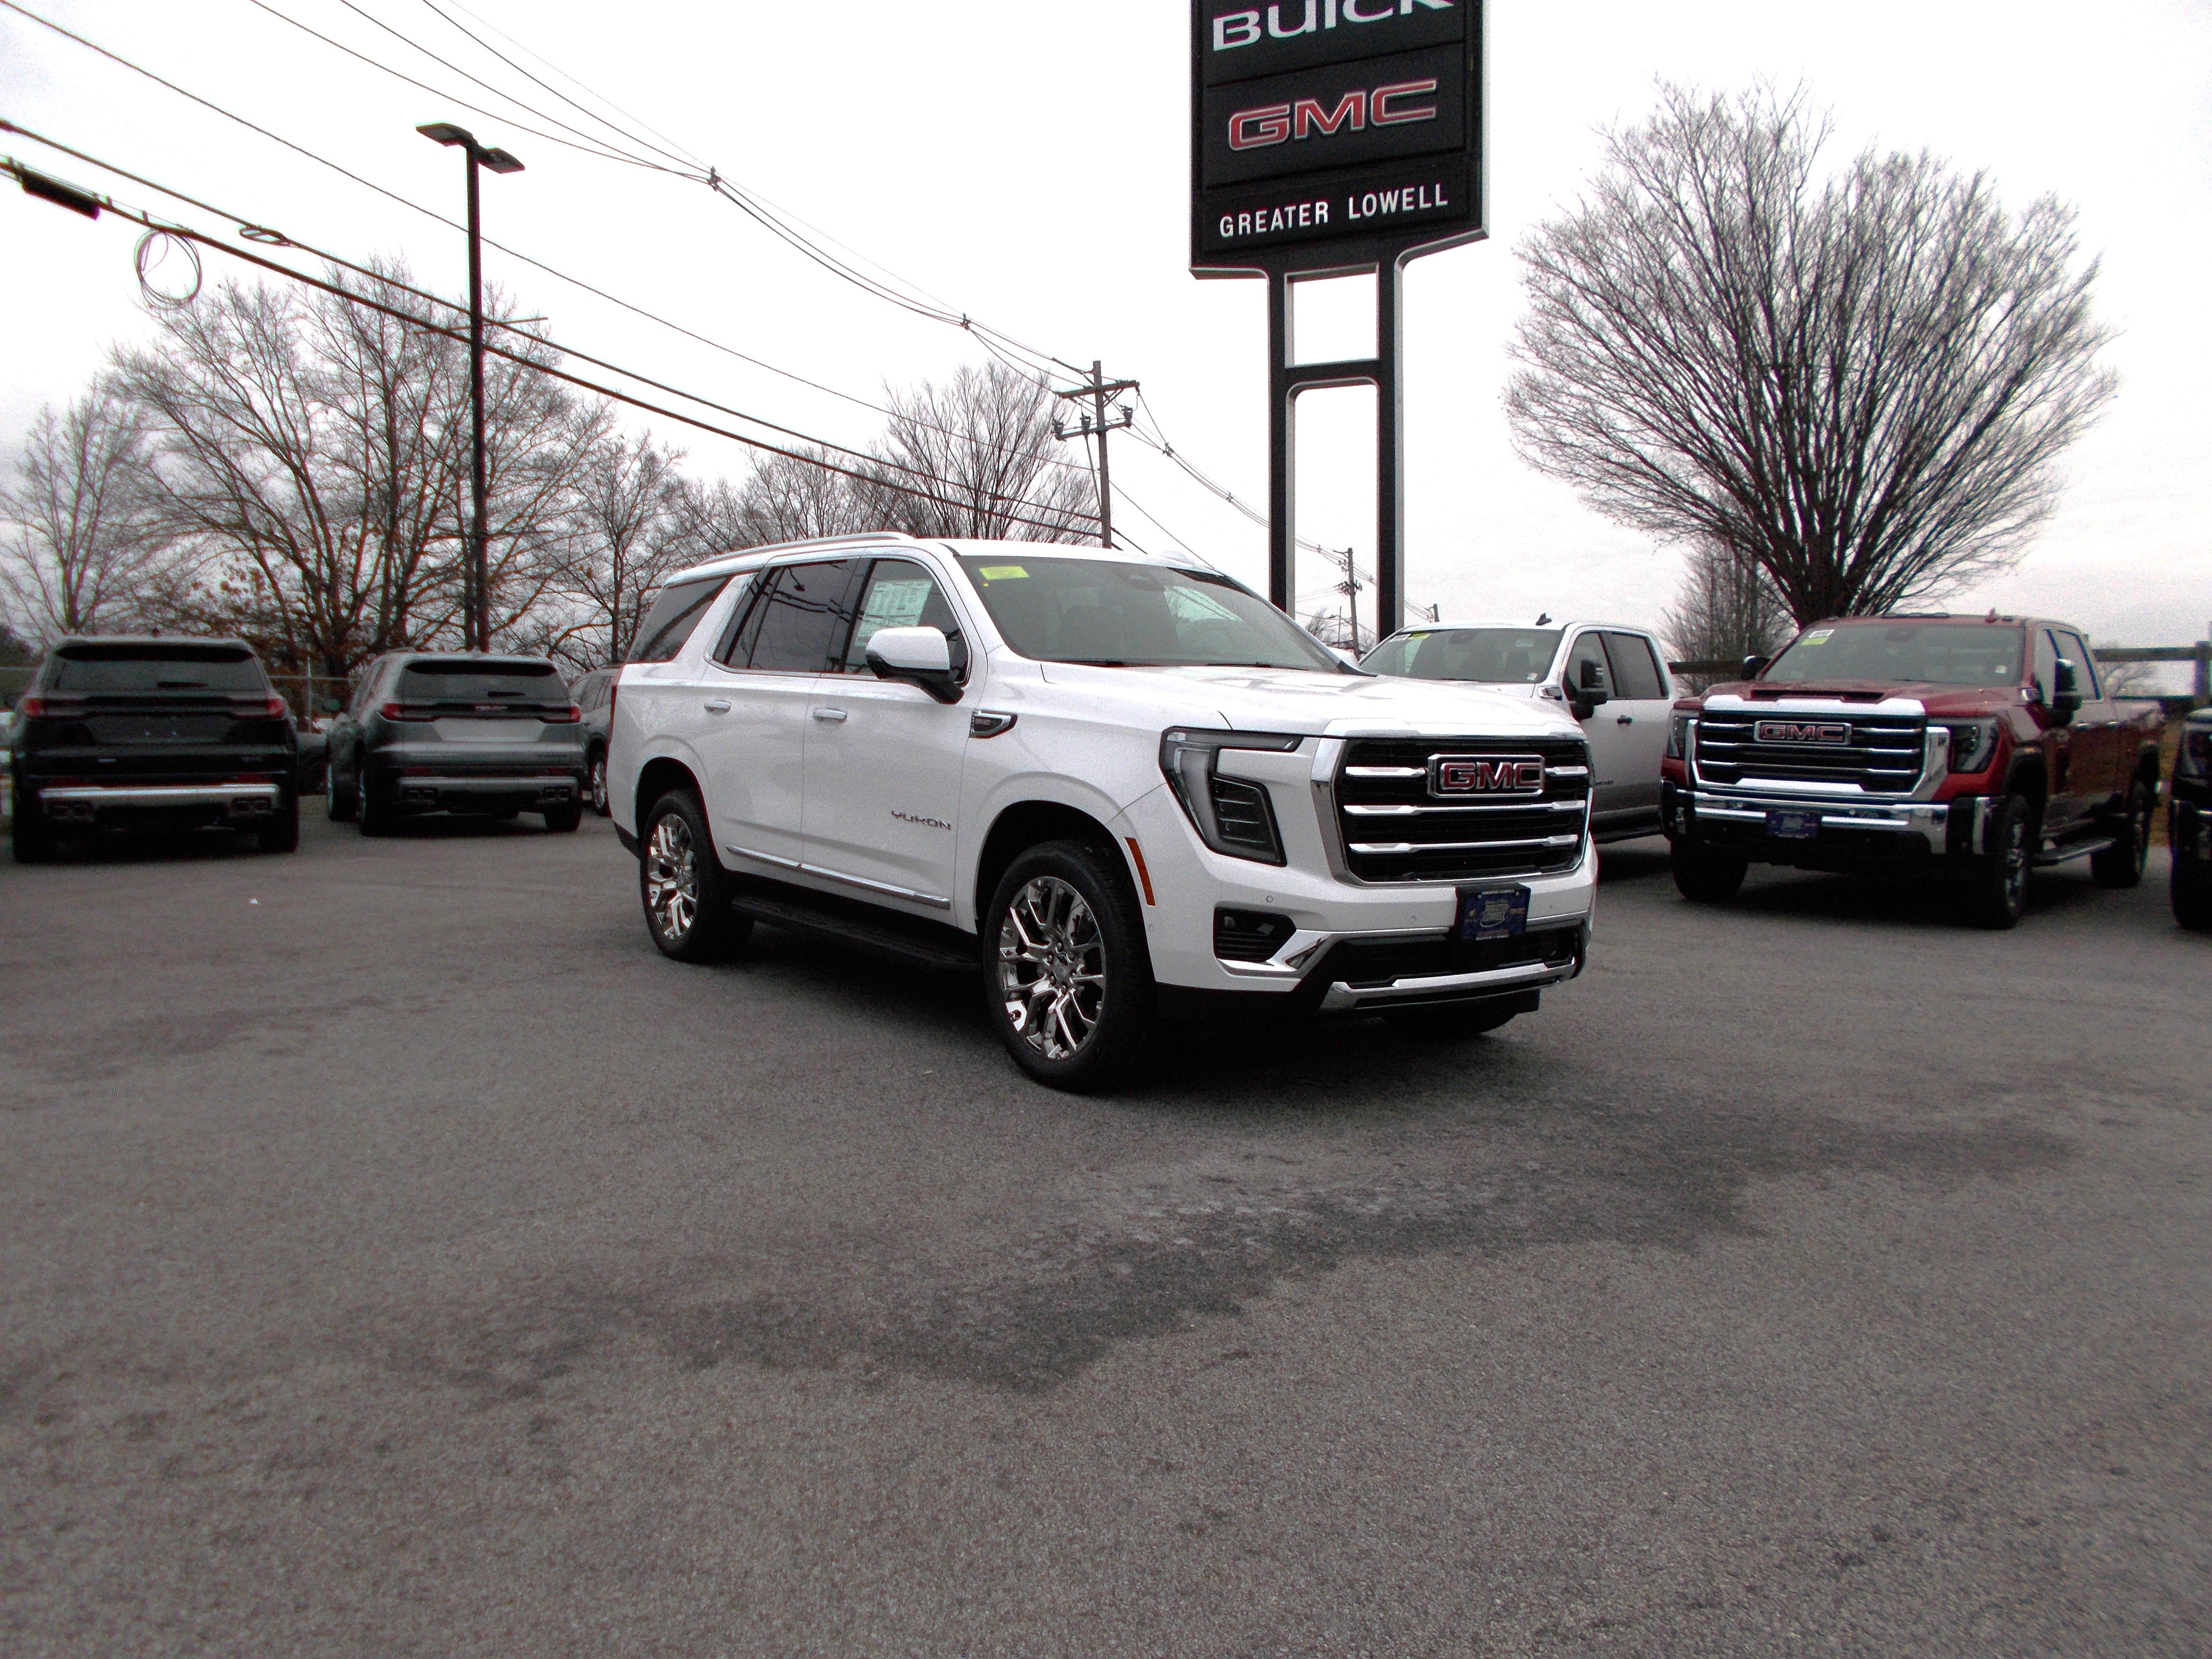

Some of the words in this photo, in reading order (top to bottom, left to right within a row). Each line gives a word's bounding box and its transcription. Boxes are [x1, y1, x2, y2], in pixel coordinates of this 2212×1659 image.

[1228, 78, 1438, 151] GMC
[1220, 200, 1329, 238] GREATER
[1348, 182, 1448, 219] LOWELL
[1761, 724, 1844, 741] GMC
[1441, 762, 1541, 790] GMC
[891, 810, 952, 830] YUKON
